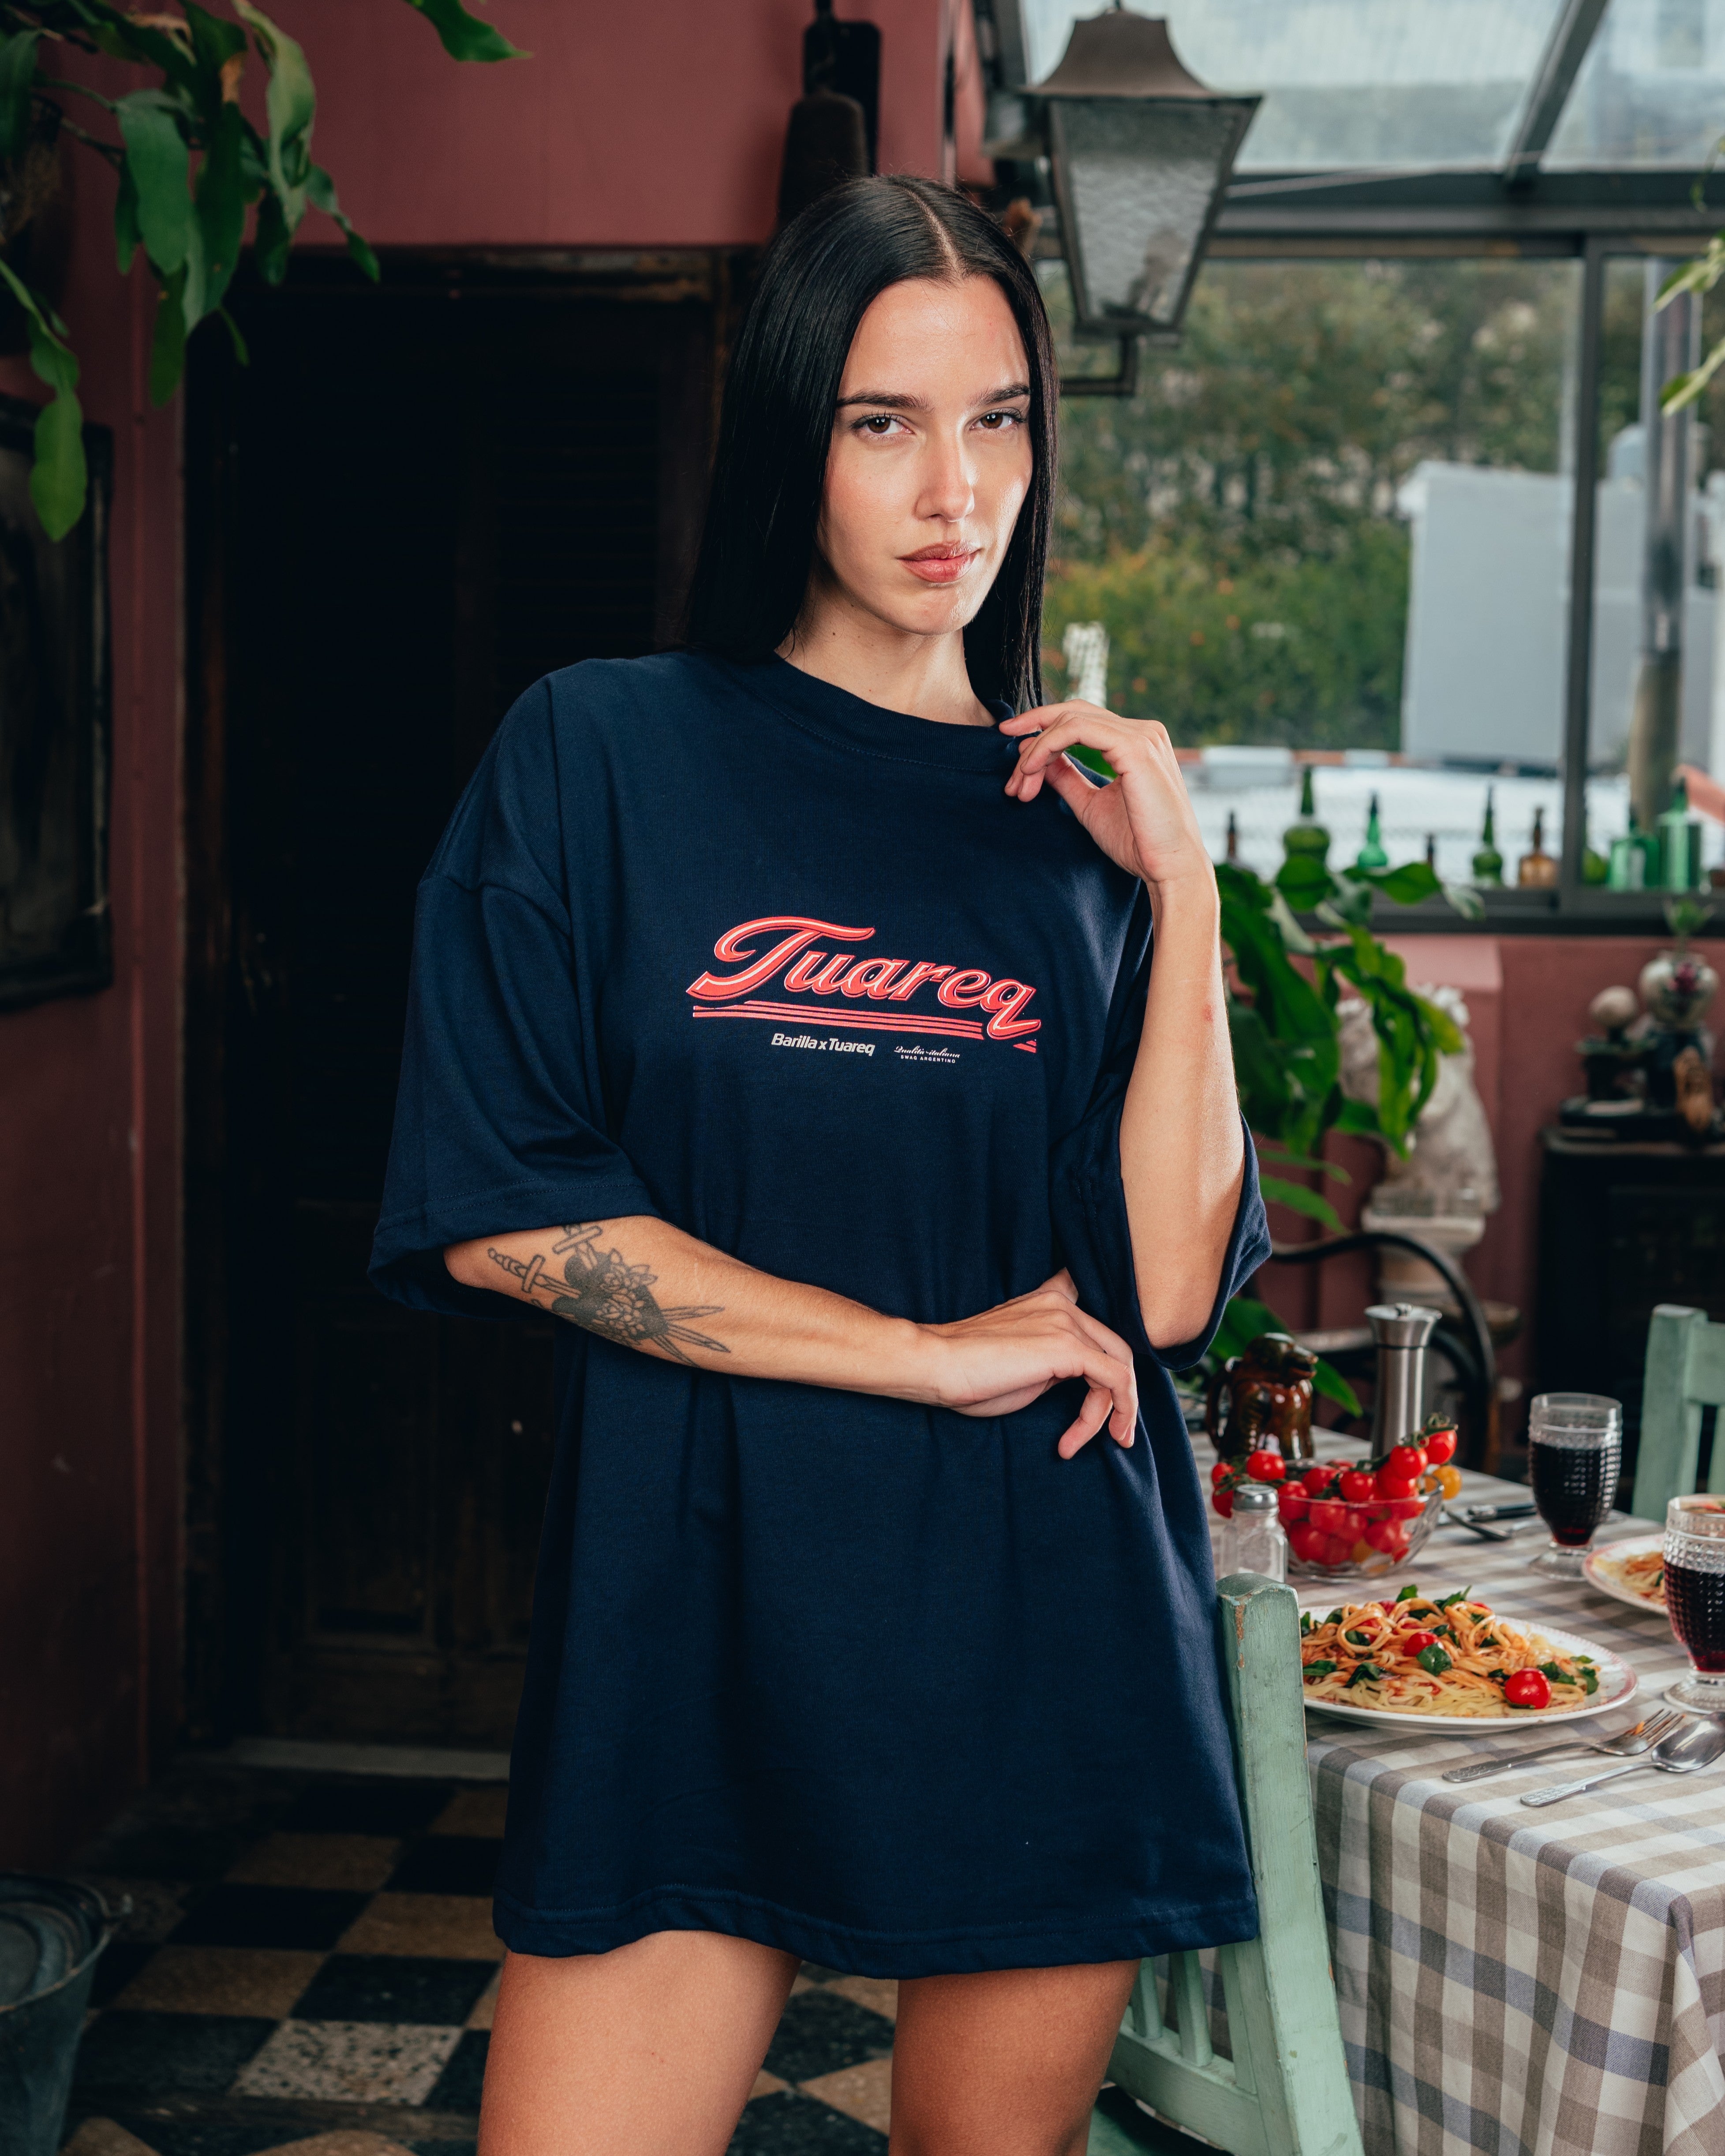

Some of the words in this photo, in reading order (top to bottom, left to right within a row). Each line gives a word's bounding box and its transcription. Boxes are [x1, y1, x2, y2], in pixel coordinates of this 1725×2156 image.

[686, 916, 1041, 1040] Tuareq
[771, 1033, 818, 1049] Barilla
[818, 1041, 828, 1050] x
[829, 1037, 876, 1056] Tuareq
[925, 1048, 960, 1058] italiana
